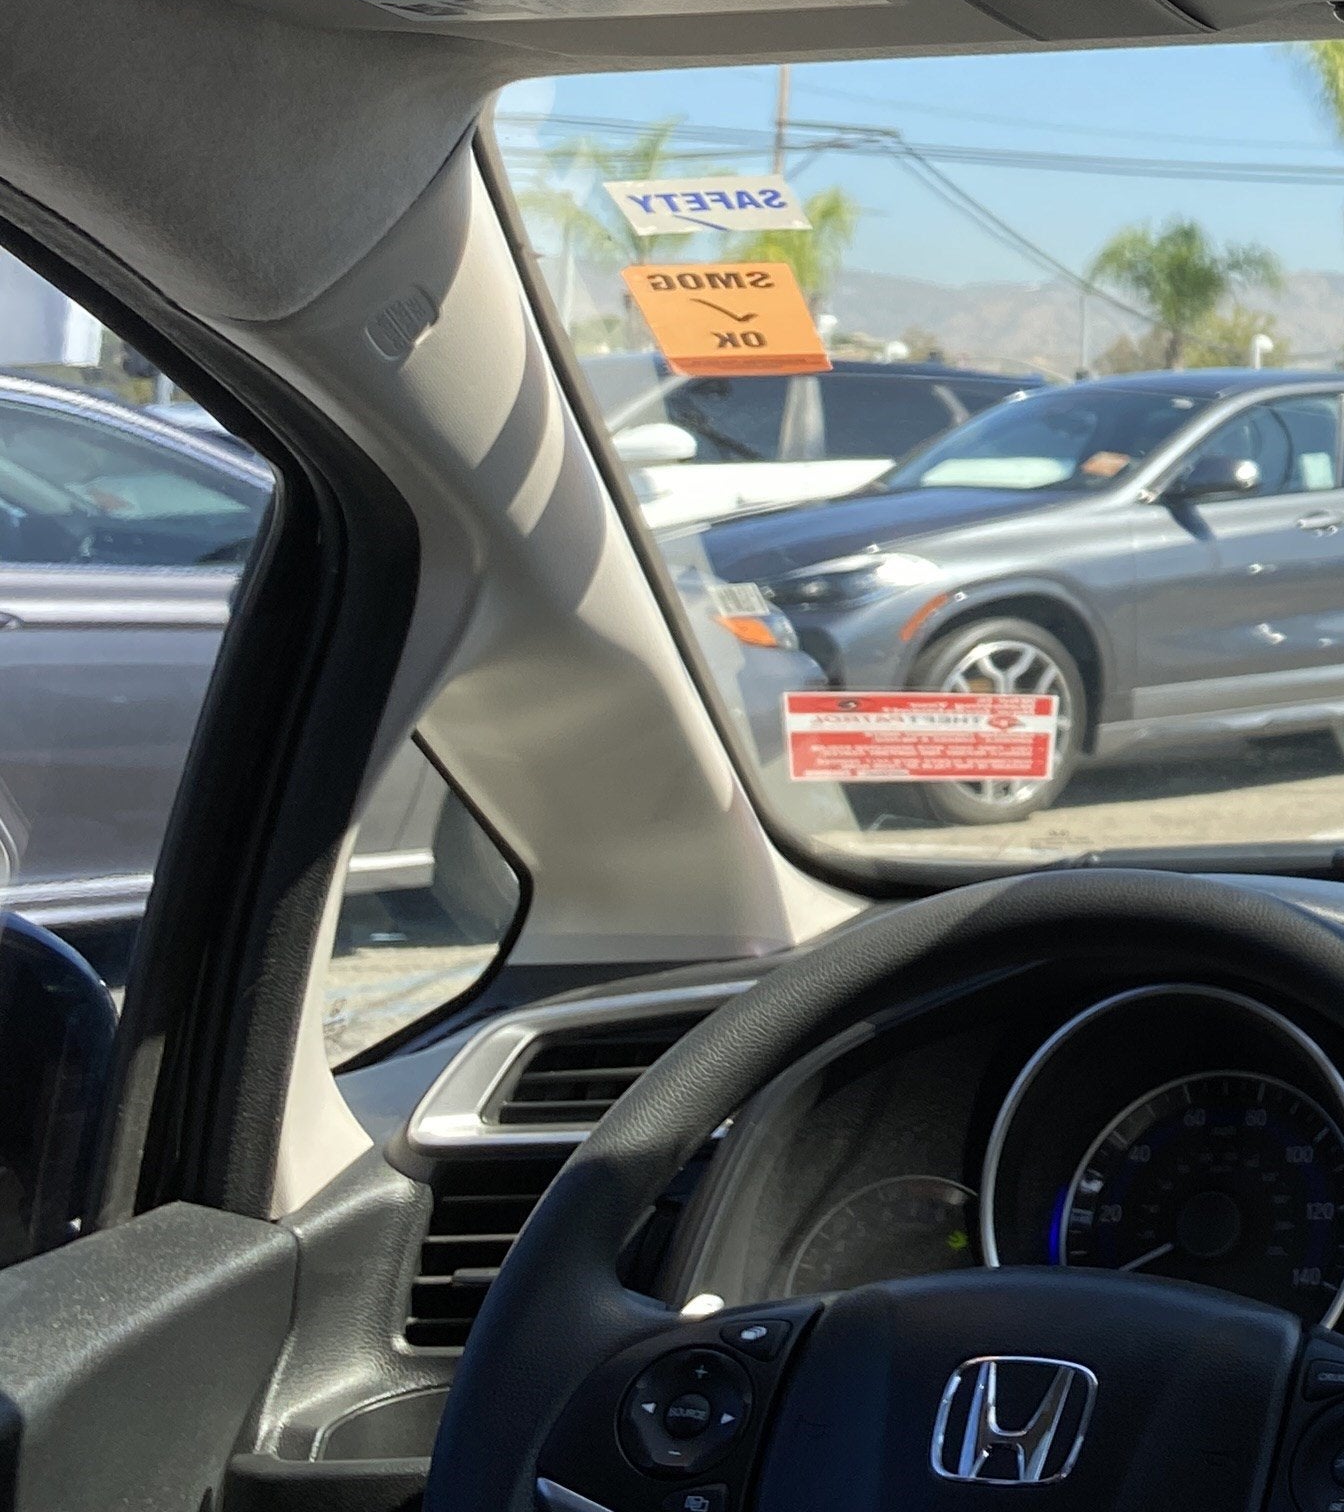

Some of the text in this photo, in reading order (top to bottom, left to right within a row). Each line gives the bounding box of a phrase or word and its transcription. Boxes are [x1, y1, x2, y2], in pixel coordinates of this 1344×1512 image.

[1286, 1146, 1313, 1163] 100
[1101, 1205, 1122, 1222] 20
[1307, 1202, 1334, 1220] 120
[1291, 1268, 1320, 1286] 140
